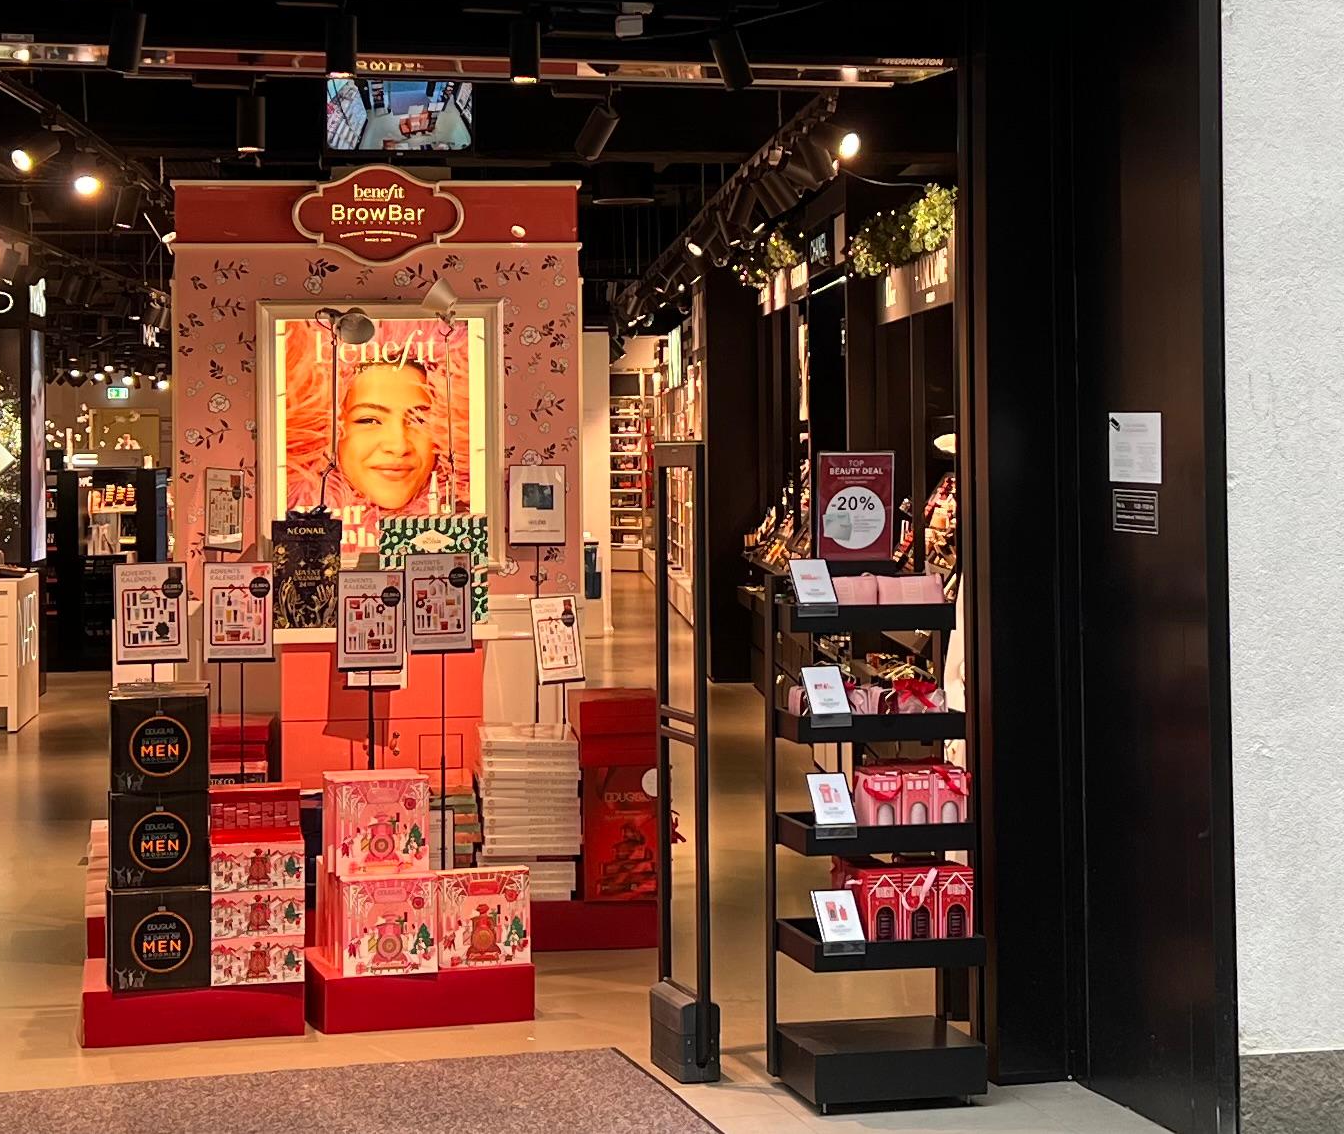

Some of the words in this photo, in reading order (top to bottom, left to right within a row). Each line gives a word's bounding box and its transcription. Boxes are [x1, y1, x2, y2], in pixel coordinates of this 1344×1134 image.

[353, 183, 405, 202] benefit
[331, 204, 425, 221] BrowBar
[848, 459, 865, 467] TOP
[829, 467, 861, 475] BEAUTY
[862, 467, 884, 475] DEAL
[831, 496, 876, 511] -20%
[140, 743, 180, 758] MEN
[140, 838, 180, 853] MEN
[142, 939, 182, 954] MEN
